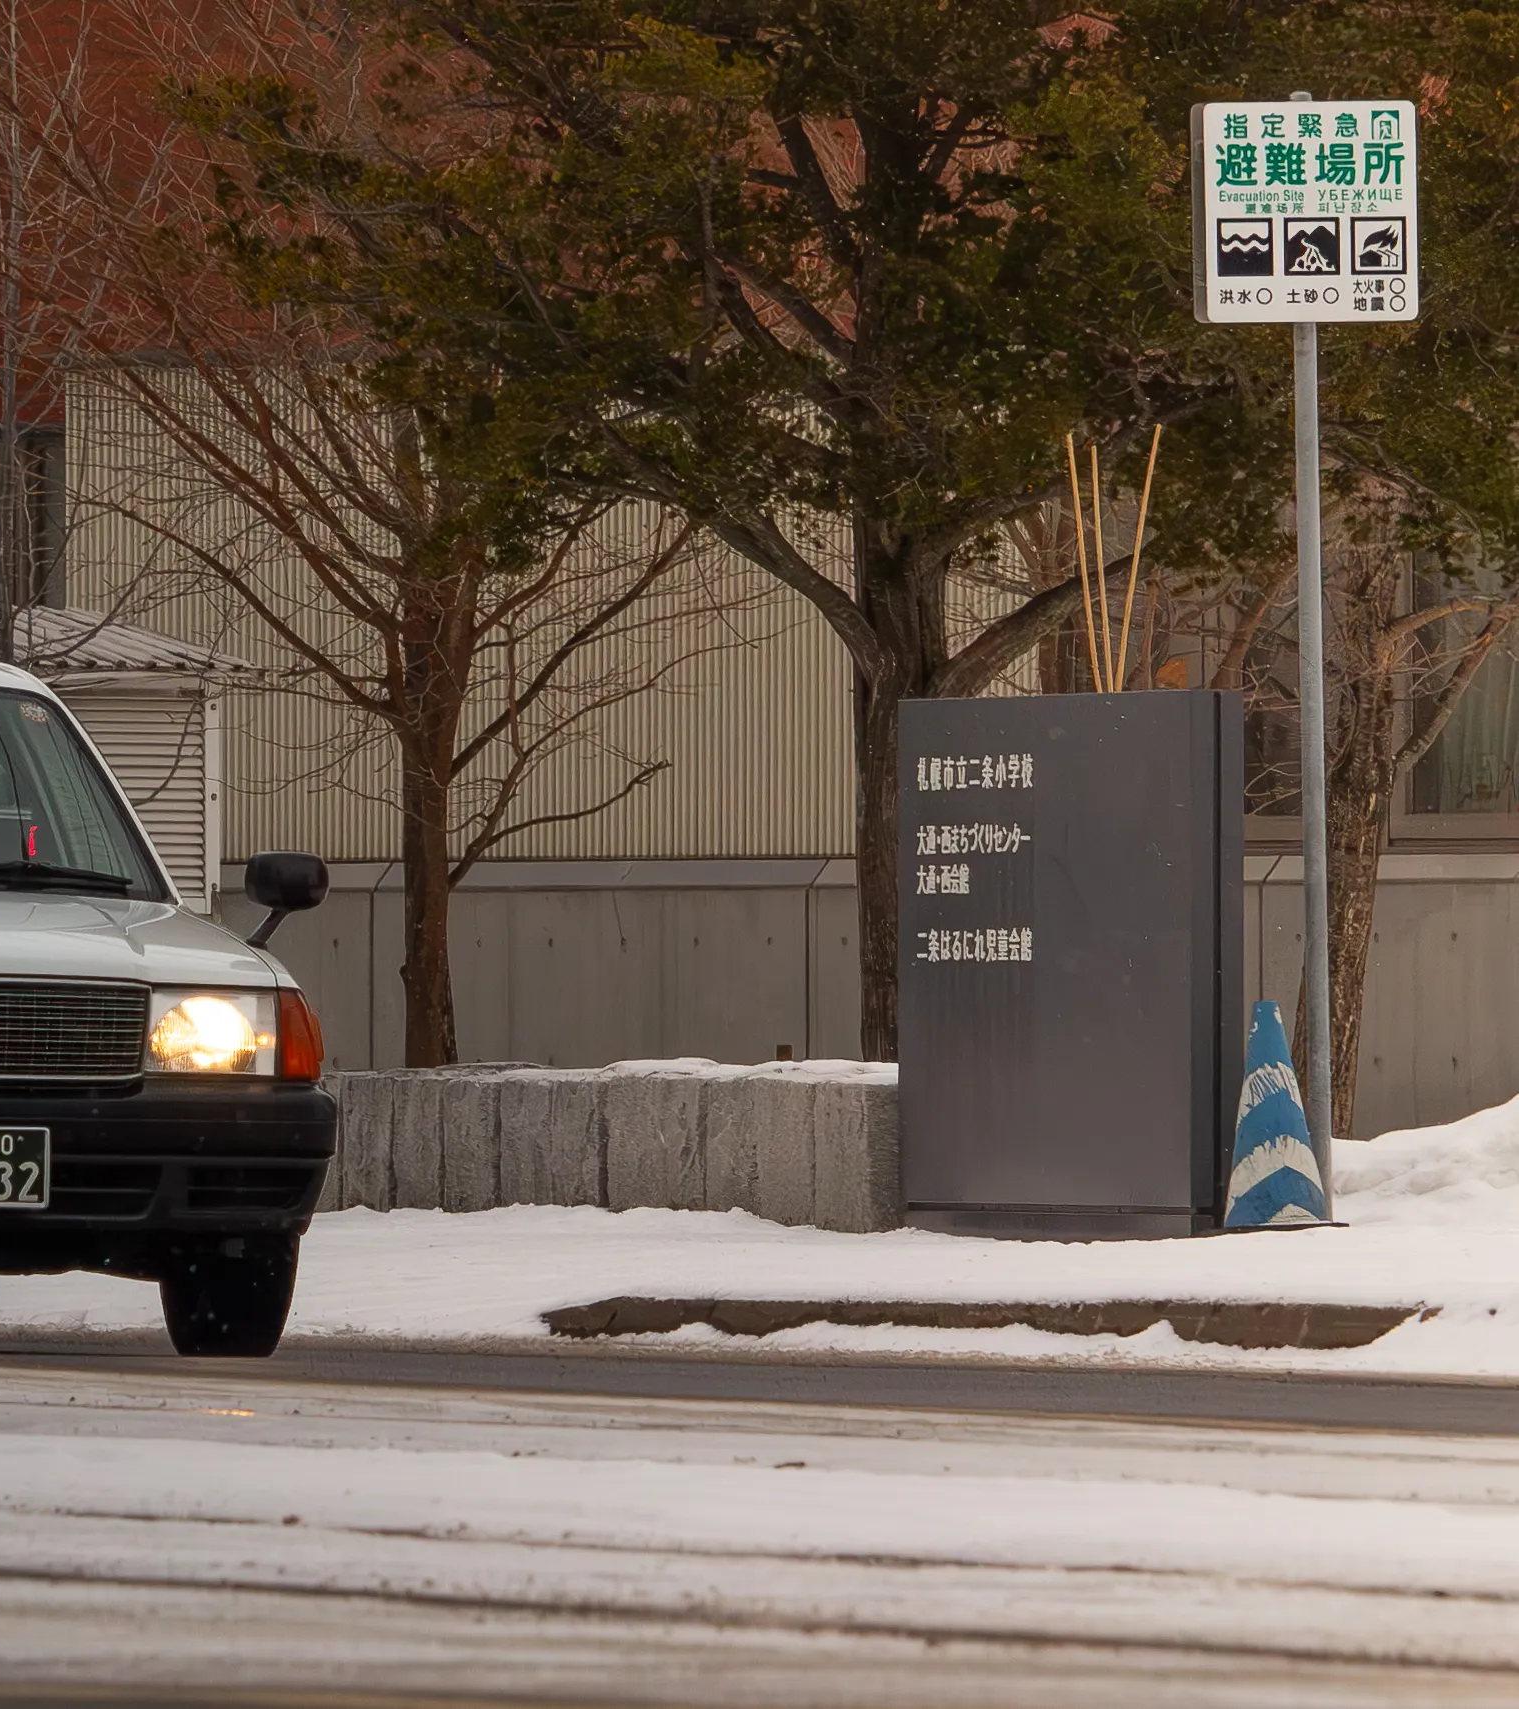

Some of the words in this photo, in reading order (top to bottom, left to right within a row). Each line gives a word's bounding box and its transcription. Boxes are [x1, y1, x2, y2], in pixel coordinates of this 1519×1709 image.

[1224, 113, 1359, 139] 指定緊急
[1216, 142, 1405, 187] 避難場所
[1219, 190, 1280, 203] Evacuation
[1283, 190, 1305, 202] Site
[1318, 189, 1403, 202] УБЕЖИЩЕ
[1219, 289, 1252, 304] 洪水
[1286, 289, 1318, 304] 土砂
[917, 754, 1034, 791] 札幌市立二条小学校
[917, 928, 1033, 962] 二条はるにれ児童会館
